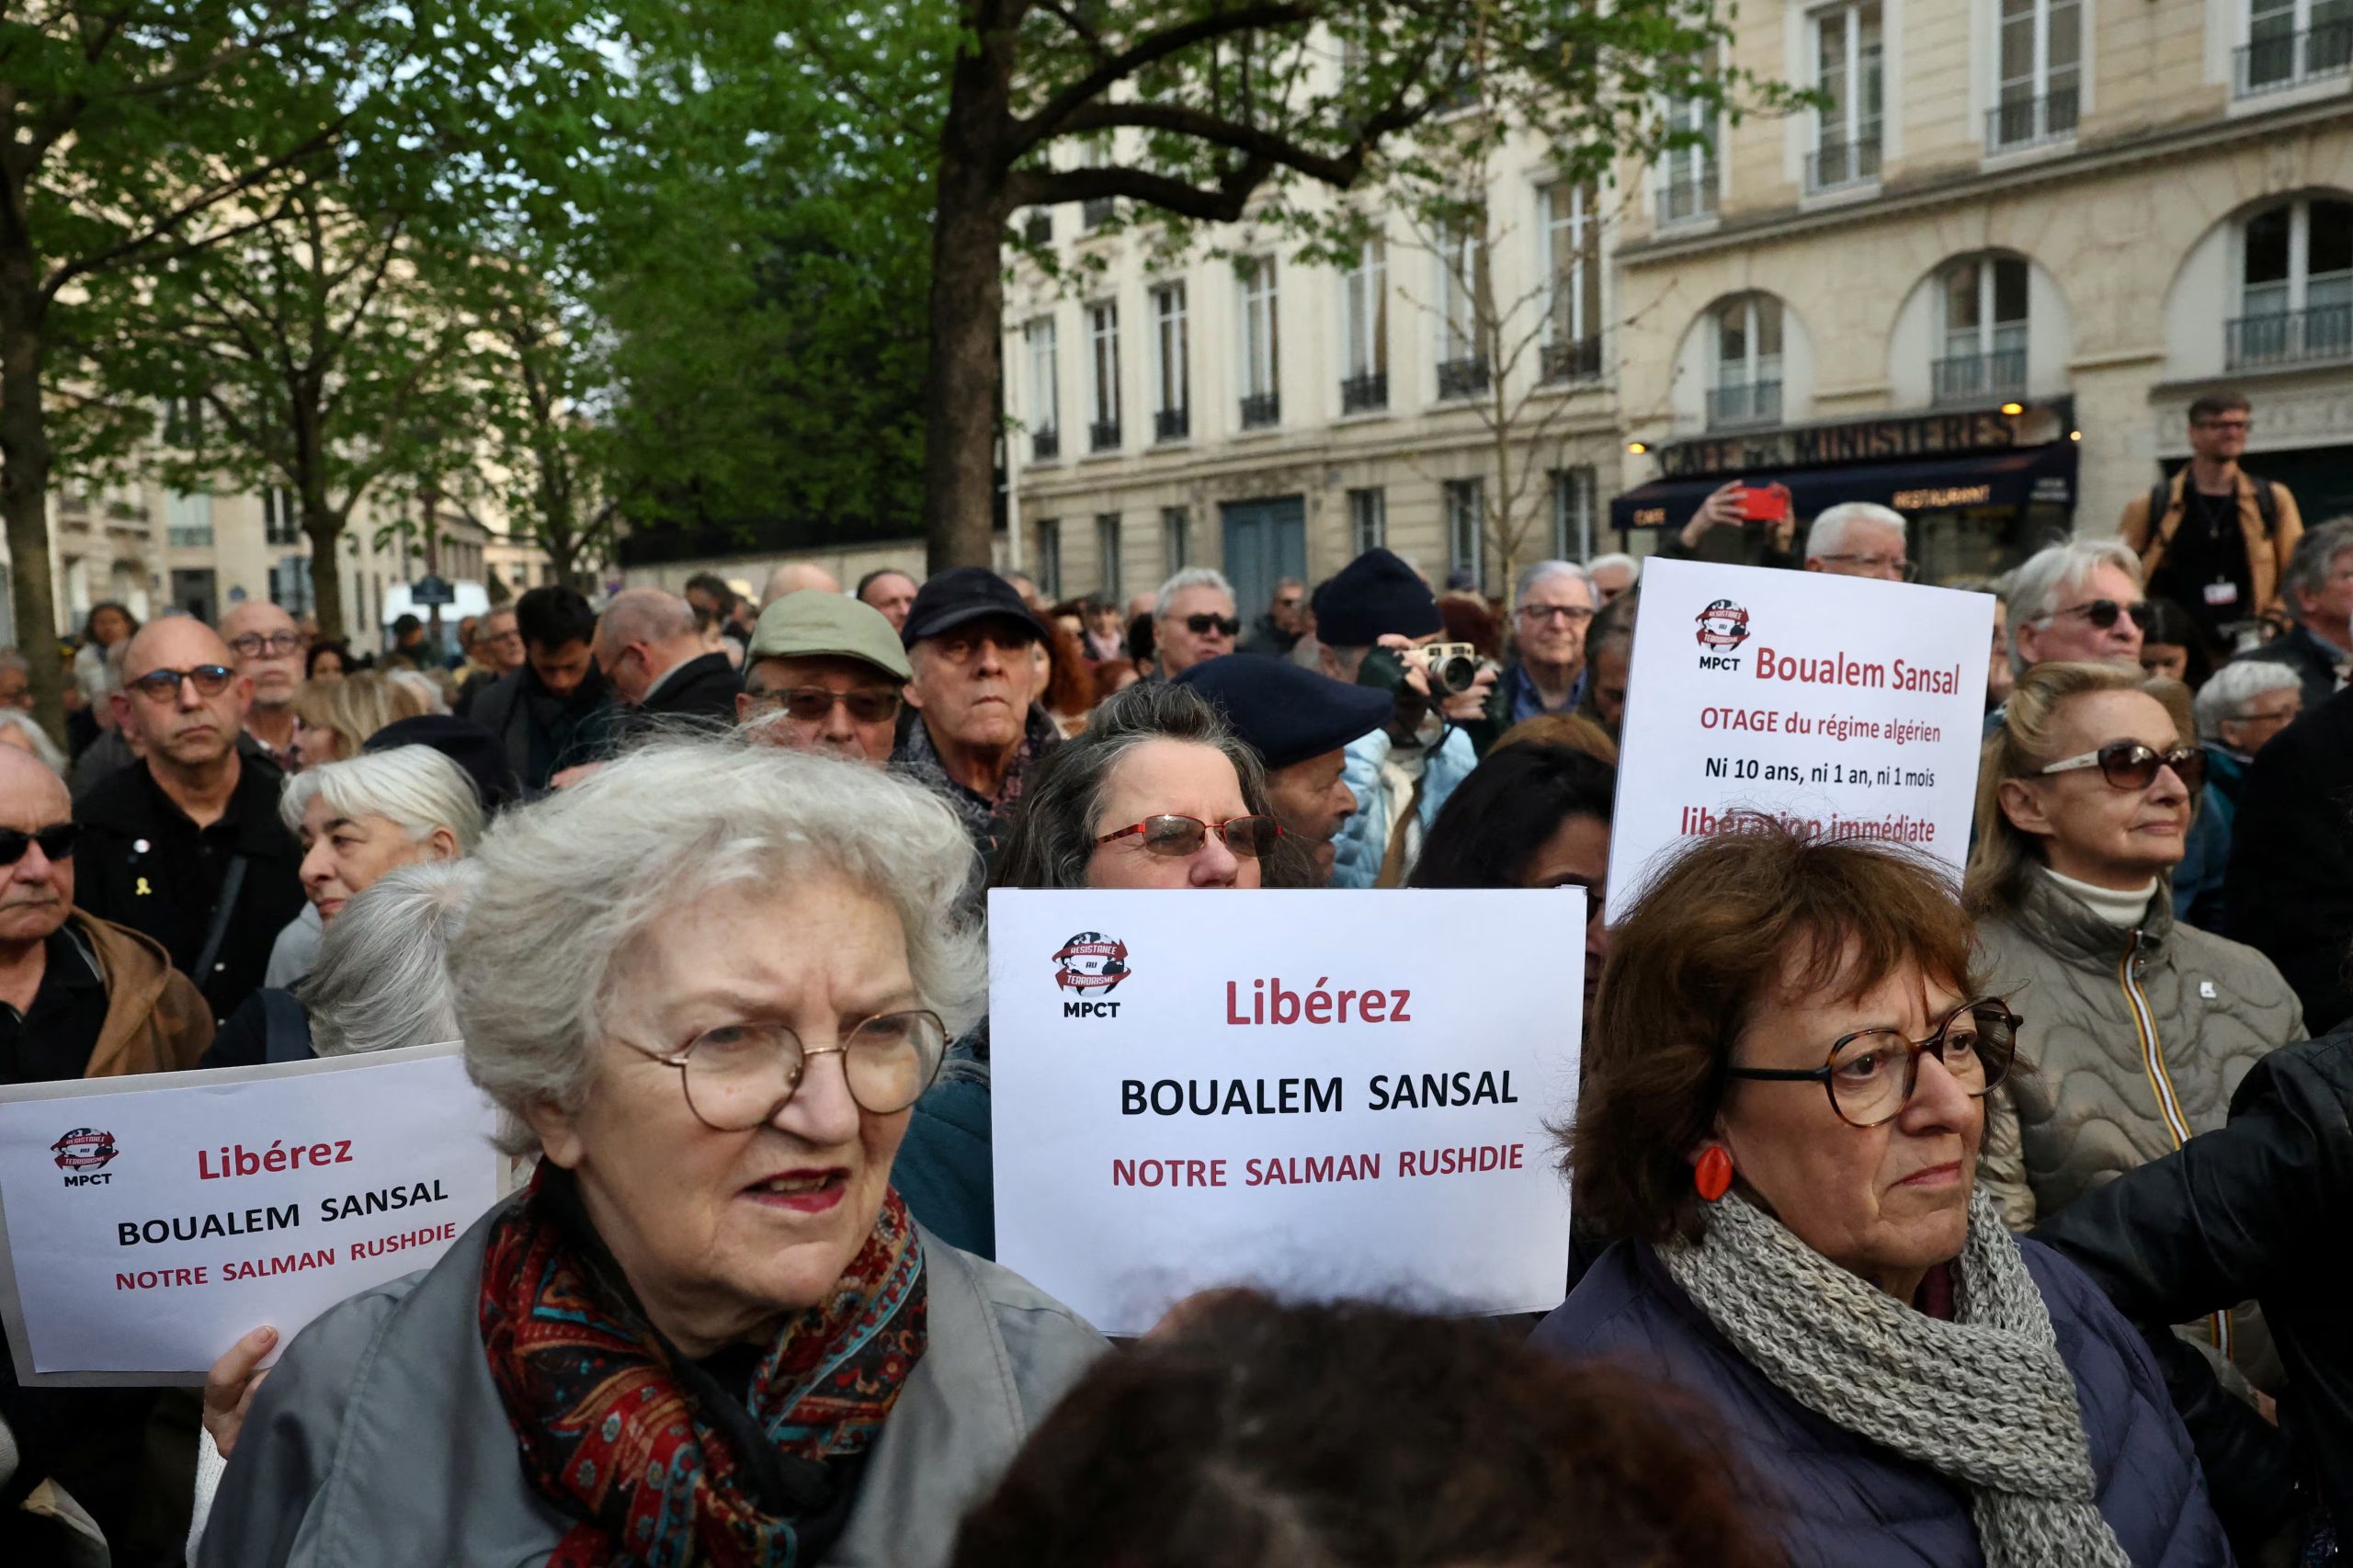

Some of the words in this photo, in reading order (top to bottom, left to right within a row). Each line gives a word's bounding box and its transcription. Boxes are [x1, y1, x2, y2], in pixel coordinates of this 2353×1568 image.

[1699, 655, 1741, 671] MPCT
[1756, 646, 1885, 688] Boualem
[1892, 658, 1961, 696] Sansal
[1700, 707, 1779, 733] OTAGE
[1784, 710, 1812, 734] du
[1817, 713, 1880, 742] régime
[1883, 718, 1941, 745] algérien
[1705, 757, 1728, 778] Ni
[1733, 758, 1759, 779] 10
[1764, 765, 1804, 786] ans,
[1811, 762, 1828, 783] ni
[1834, 764, 1843, 783] 1
[1848, 769, 1872, 788] an,
[1877, 766, 1891, 785] ni
[1893, 767, 1902, 786] 1
[1905, 767, 1935, 788] mois
[1831, 812, 1936, 842] immédiate
[1070, 944, 1118, 955] RESISTANCE
[1066, 974, 1115, 986] TERRORISME
[1063, 1002, 1121, 1018] MPCT
[1226, 976, 1412, 1026] Libérez
[1121, 1076, 1343, 1116] BOUALEM
[1368, 1070, 1518, 1111] SANSAL
[198, 1139, 354, 1180] Libérez
[1113, 1159, 1227, 1187] NOTRE
[1245, 1153, 1381, 1187] SALMAN
[1398, 1143, 1524, 1178] RUSHDIE
[63, 1173, 112, 1187] MPCT
[118, 1203, 300, 1246] BOUALEM
[321, 1179, 449, 1222] SANSAL
[115, 1266, 209, 1290] NOTRE
[222, 1247, 335, 1282] SALMAN
[350, 1221, 457, 1261] RUSHDIE
